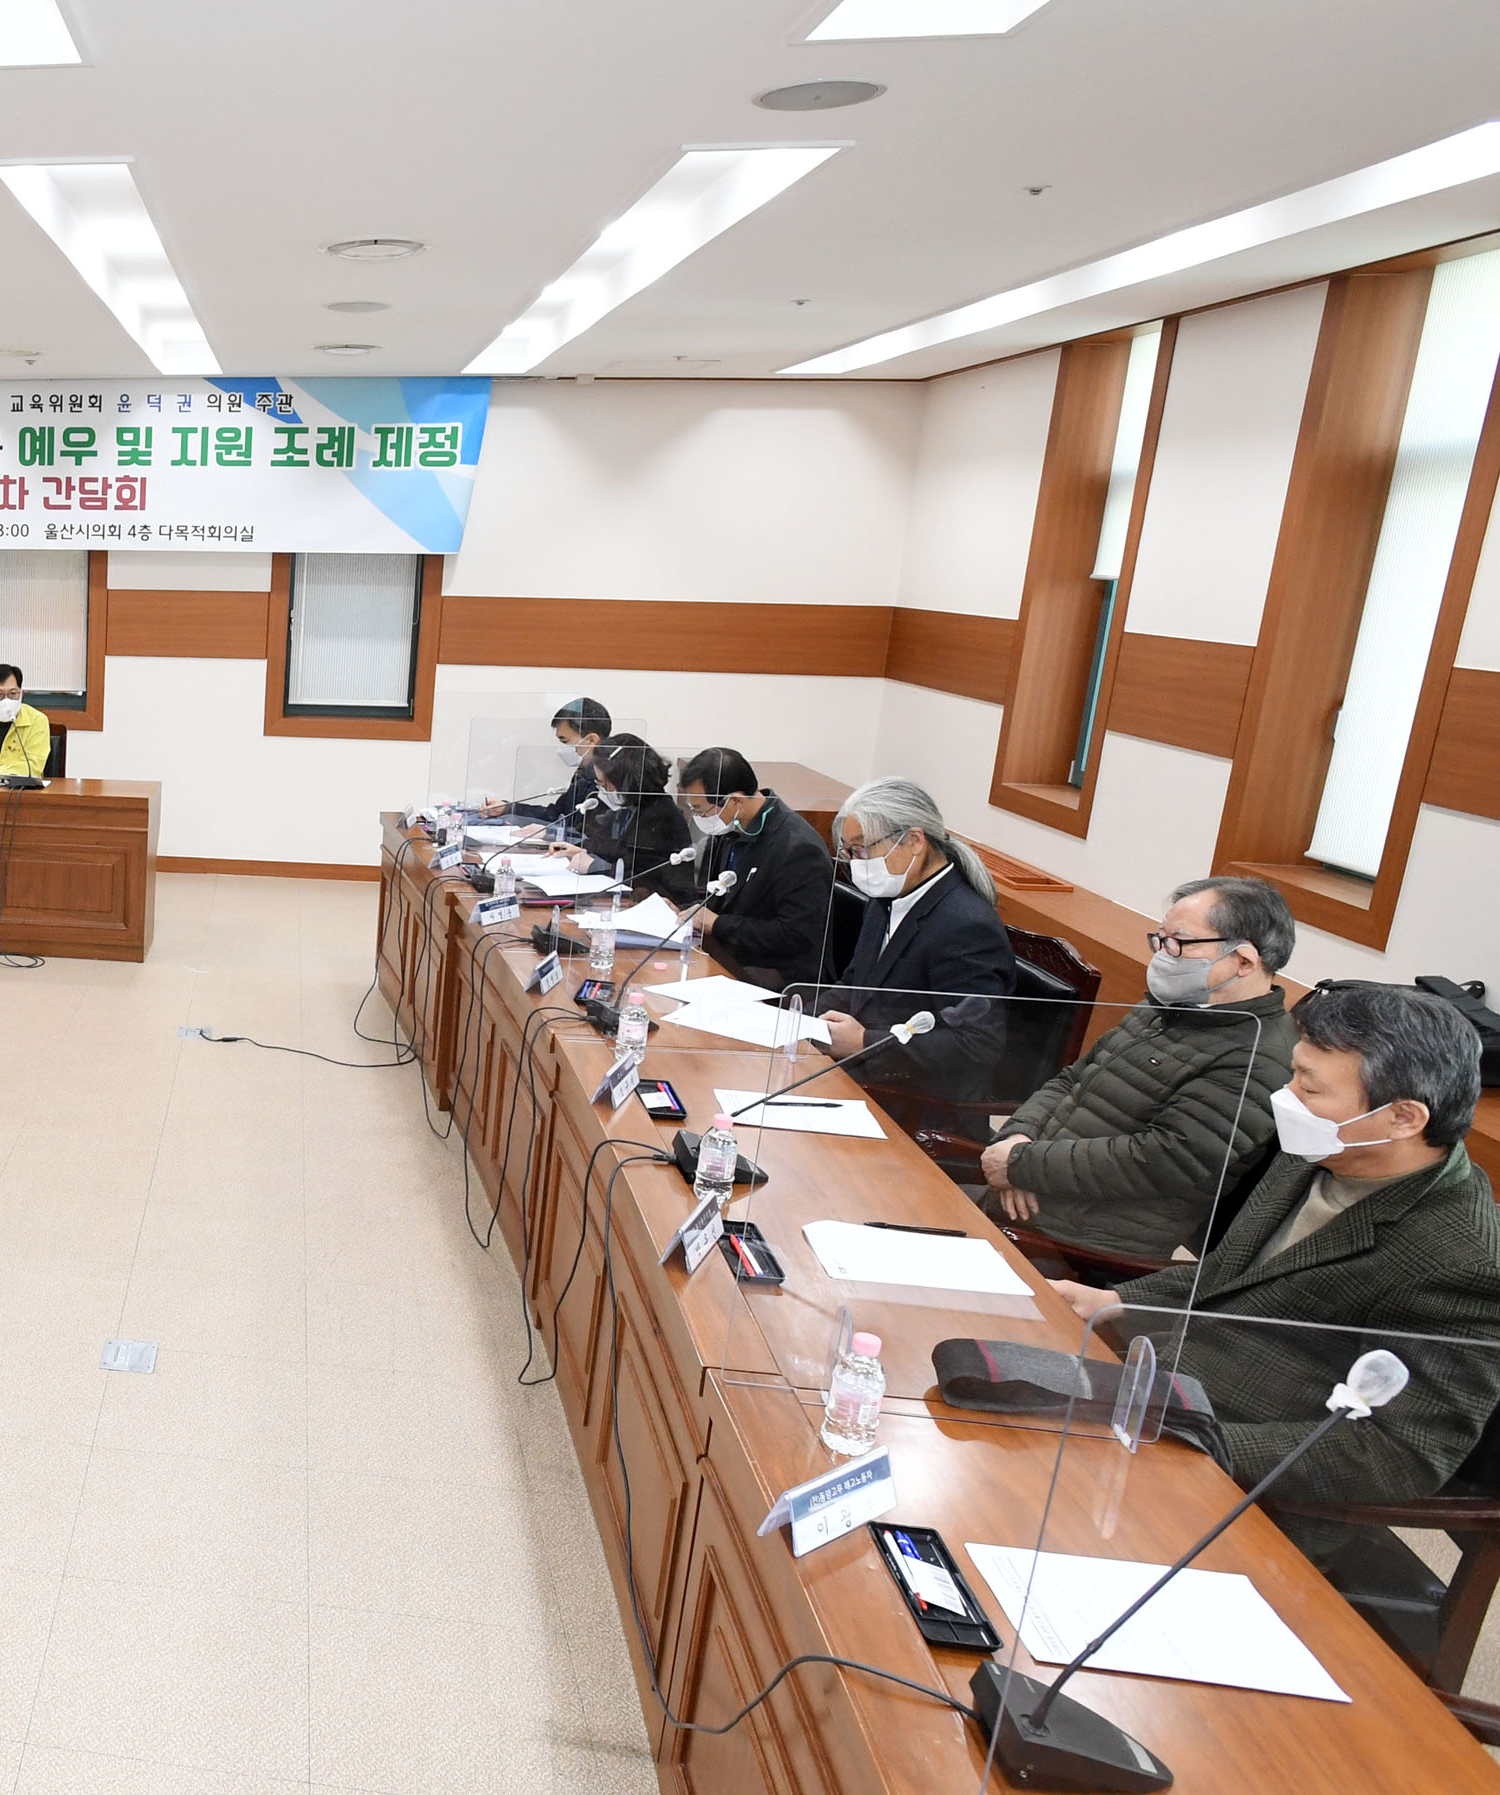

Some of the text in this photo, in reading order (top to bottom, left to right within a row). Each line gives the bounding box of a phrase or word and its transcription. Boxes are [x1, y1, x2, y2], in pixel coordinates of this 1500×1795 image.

[10, 394, 102, 414] 교육위원회
[206, 393, 243, 413] 의원
[256, 393, 294, 413] 주관
[18, 426, 98, 467] 예우
[115, 426, 153, 467] 및
[170, 426, 253, 467] 지원
[269, 426, 354, 467] 조례
[372, 426, 460, 467] 제정
[42, 475, 148, 511] 간담회
[44, 523, 122, 540] 울산시의회
[127, 523, 153, 542] 4층
[158, 524, 255, 543] 다목적회의실
